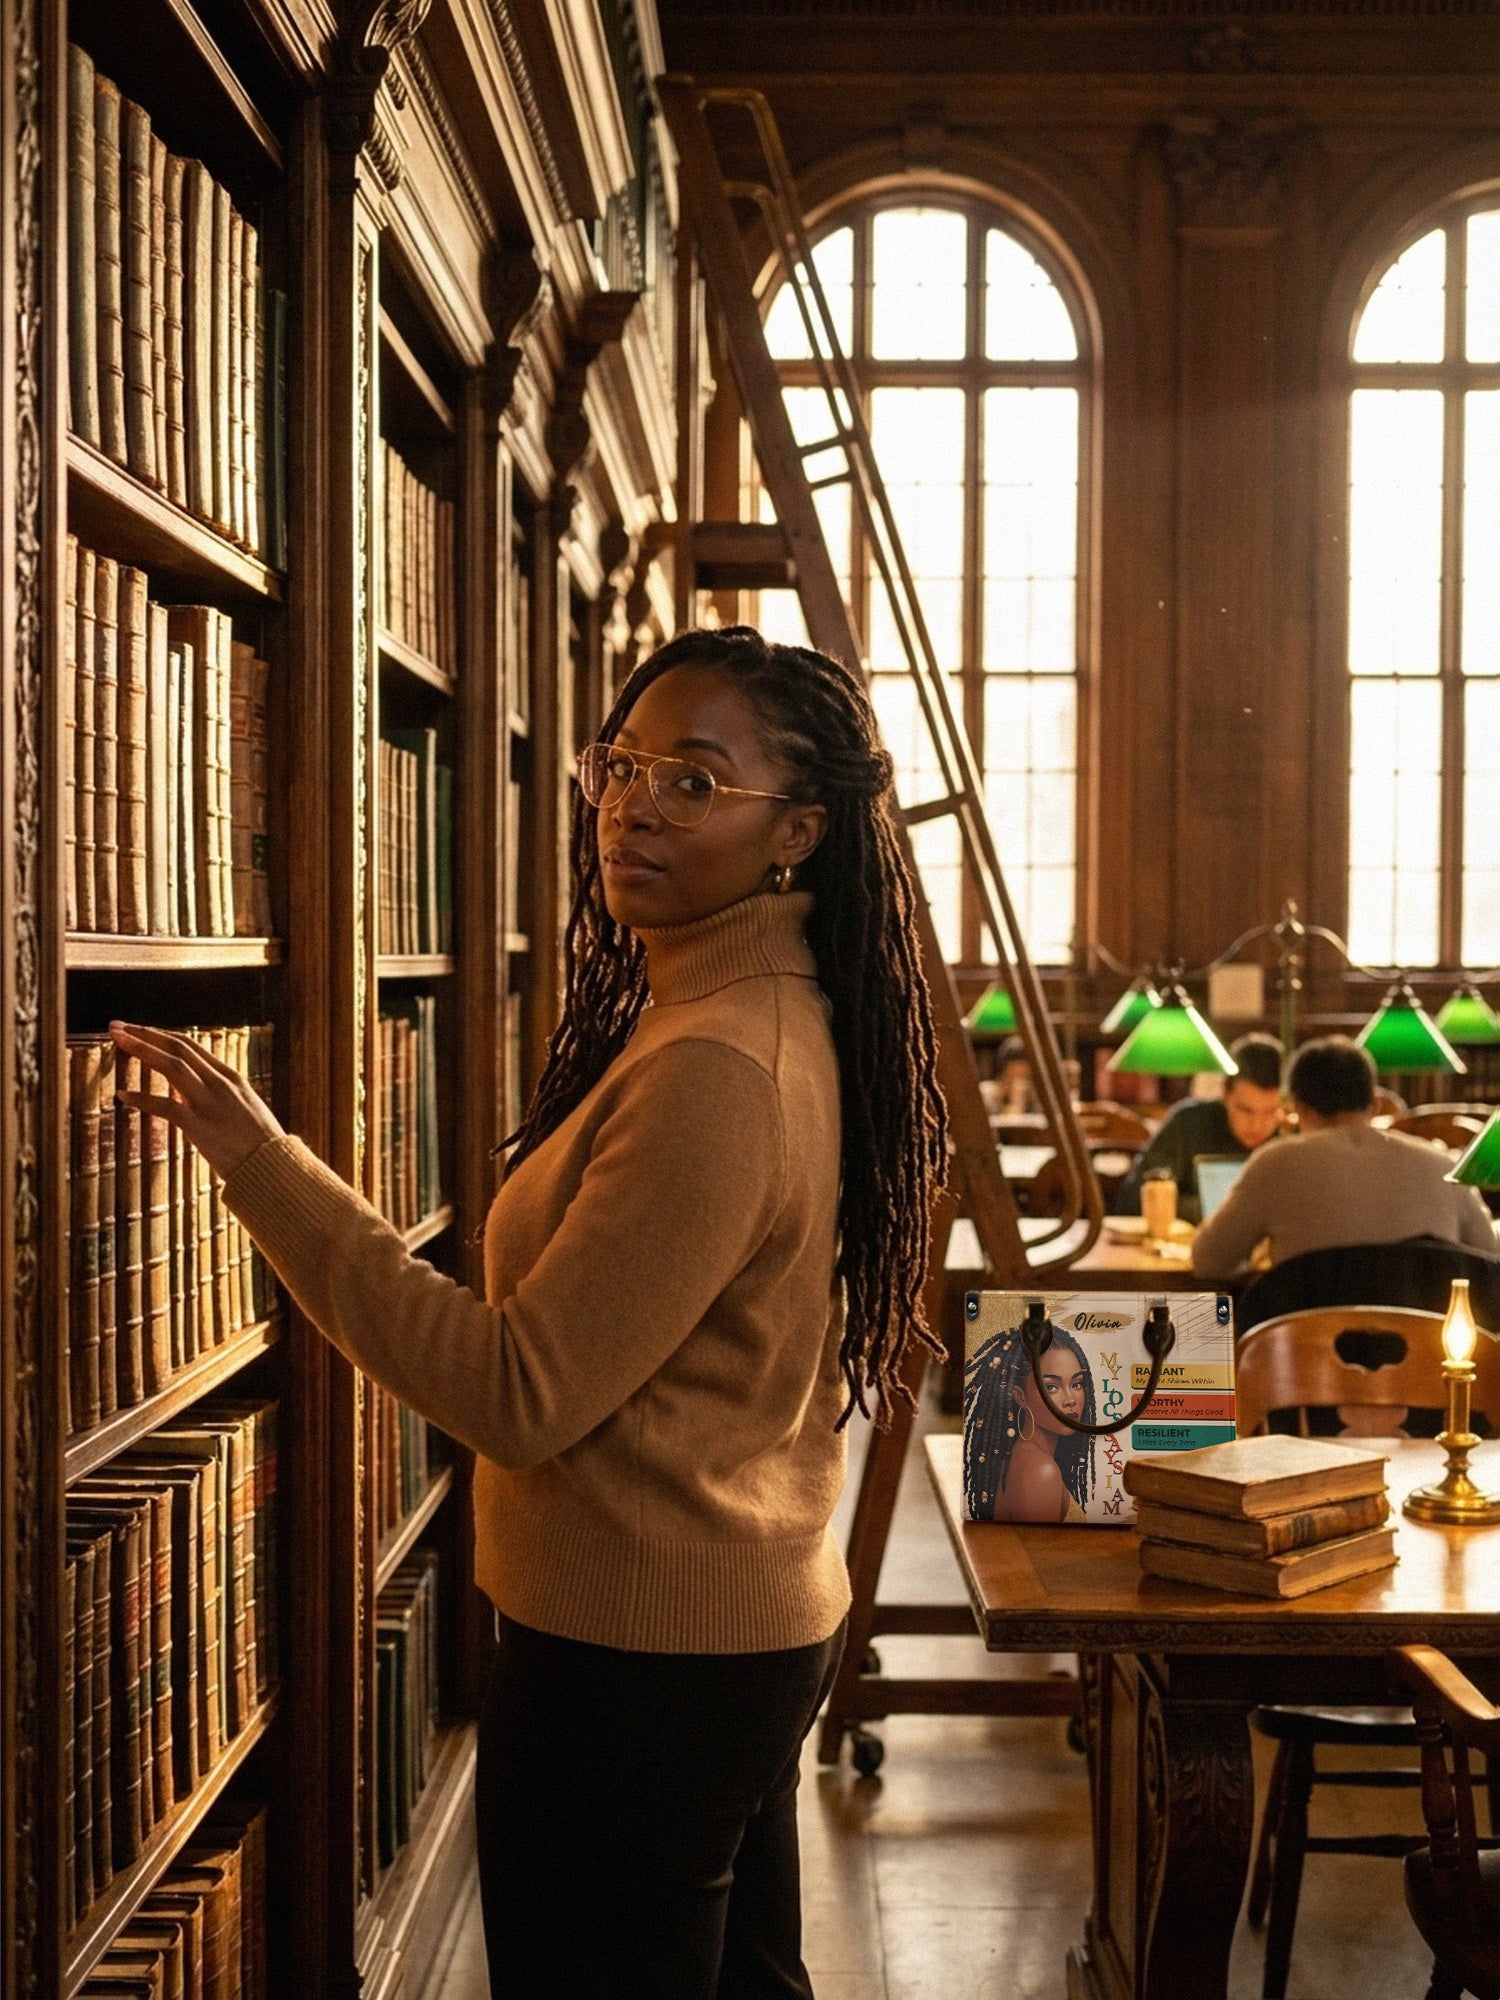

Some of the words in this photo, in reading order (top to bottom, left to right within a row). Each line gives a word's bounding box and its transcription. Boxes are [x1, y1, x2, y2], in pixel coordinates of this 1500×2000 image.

[1074, 1312, 1122, 1331] Olivia
[1100, 1352, 1122, 1380] MY
[1135, 1367, 1185, 1376] RAANT
[1137, 1398, 1185, 1407] ORTHY
[1137, 1428, 1191, 1437] RESILIENT
[1105, 1474, 1112, 1489] I
[1103, 1487, 1124, 1516] AM
